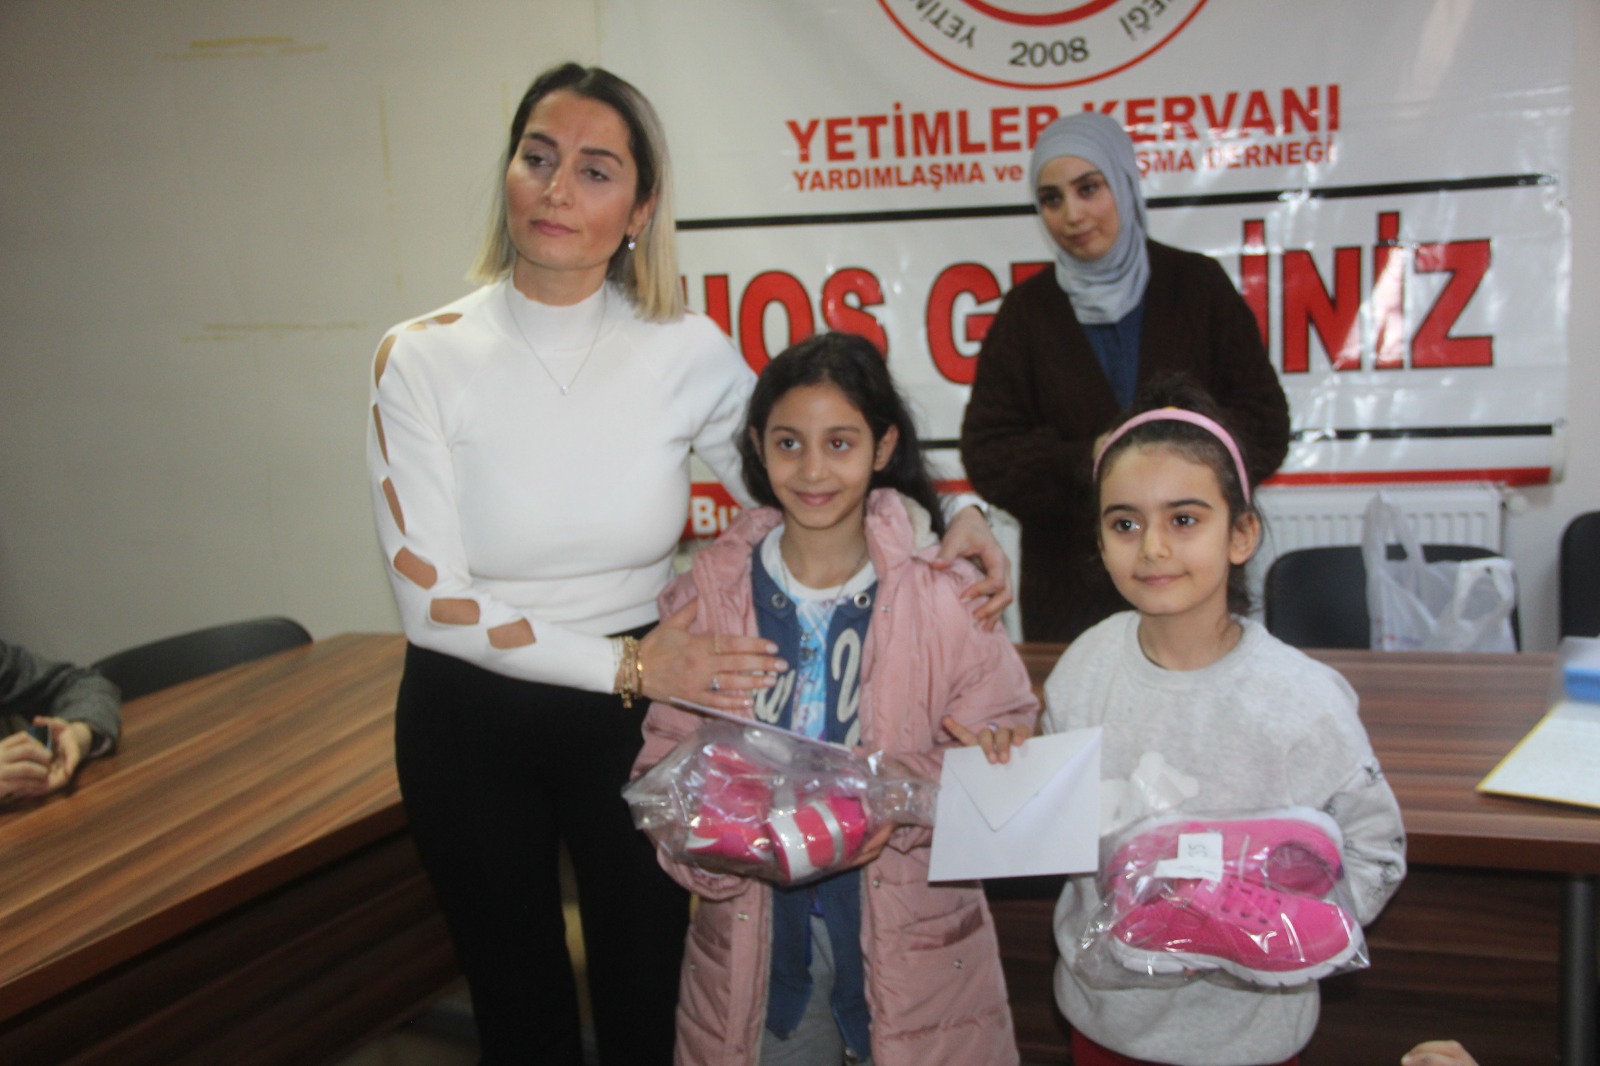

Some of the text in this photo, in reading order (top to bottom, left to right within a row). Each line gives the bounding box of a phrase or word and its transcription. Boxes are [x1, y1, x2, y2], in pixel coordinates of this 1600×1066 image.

[1008, 37, 1088, 68] 2008
[793, 162, 986, 191] YARDIMLAŞMA
[994, 164, 1023, 182] ve
